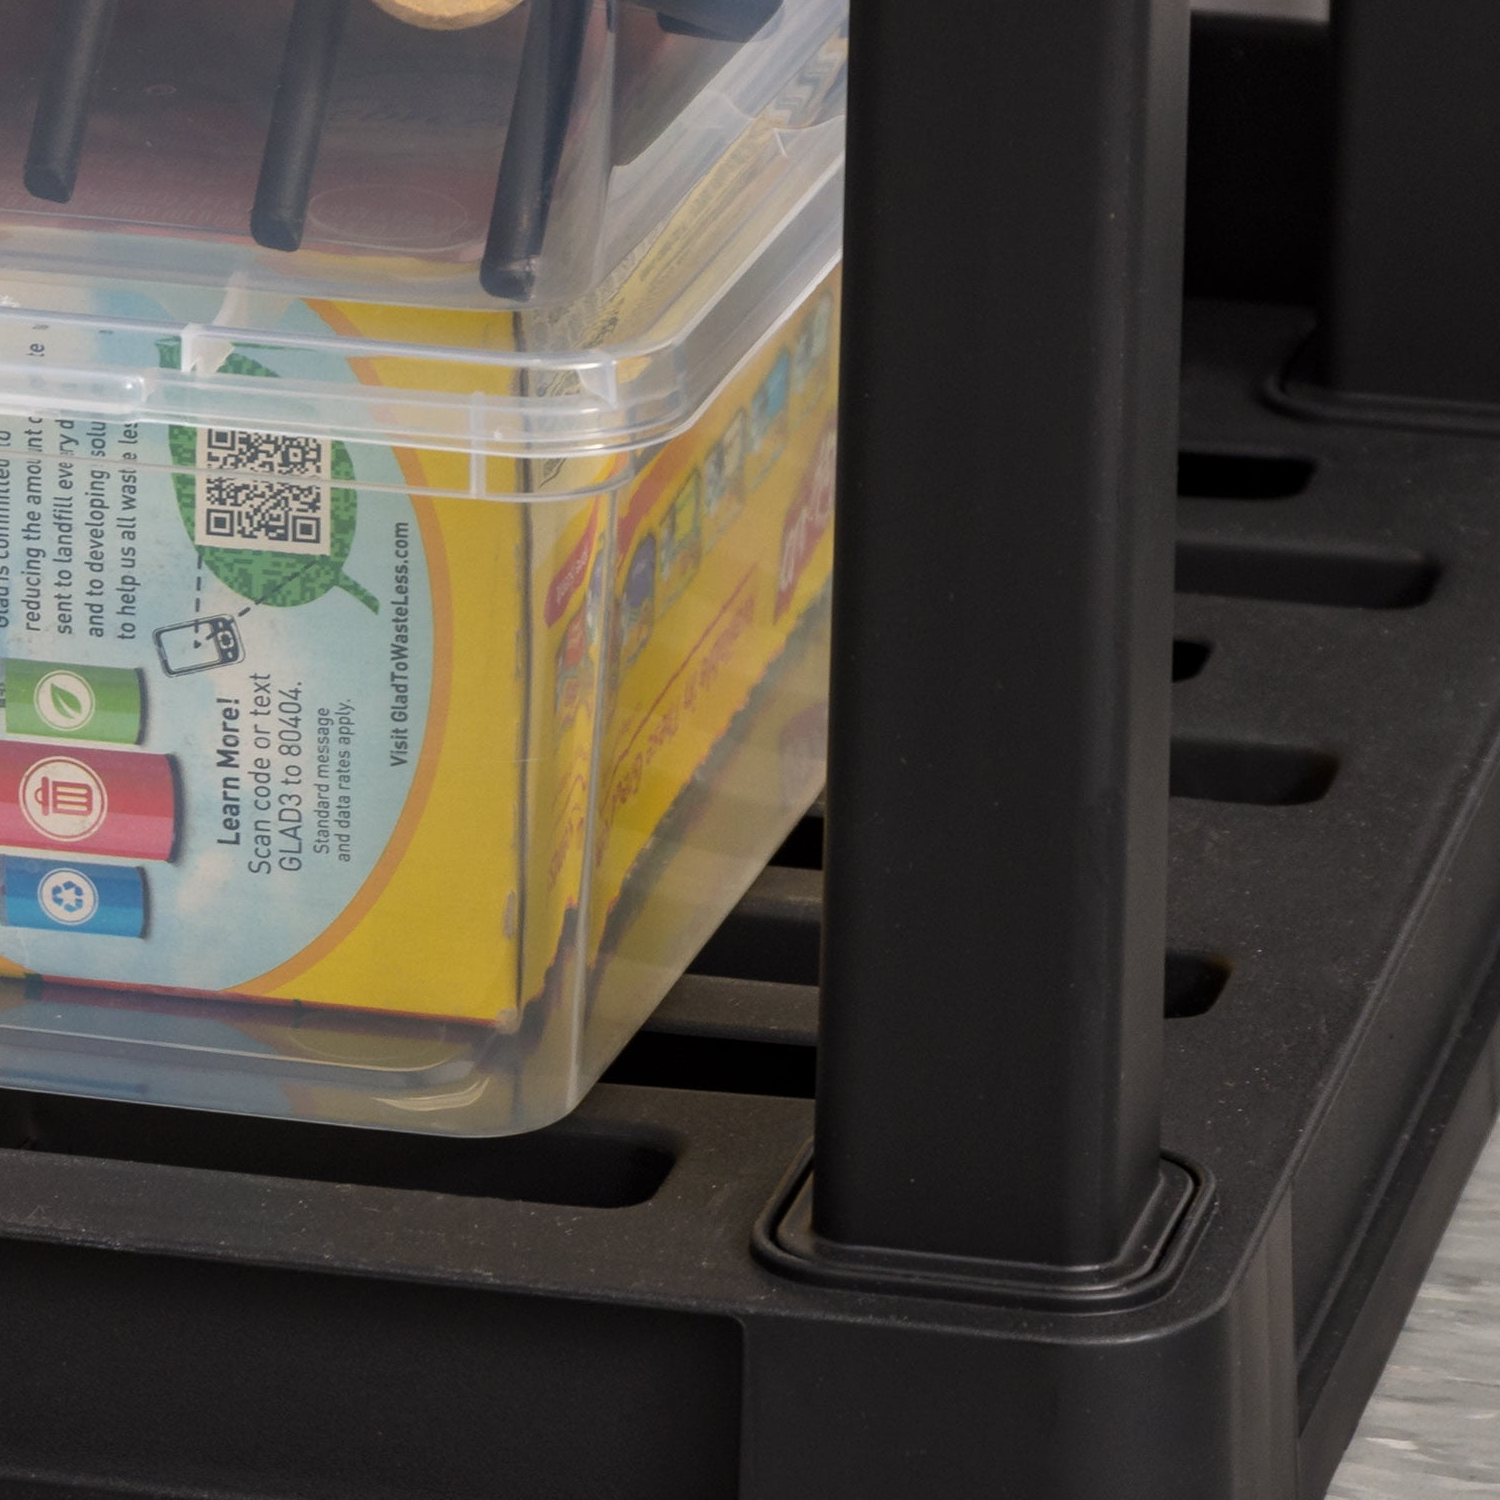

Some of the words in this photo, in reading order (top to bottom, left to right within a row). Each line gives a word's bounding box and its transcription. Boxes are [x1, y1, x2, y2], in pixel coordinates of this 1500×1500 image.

[24, 427, 43, 506] amount
[59, 432, 79, 490] every
[121, 451, 138, 512] waste
[21, 510, 42, 541] the
[53, 497, 73, 563] landfill
[85, 470, 111, 572] developing
[116, 516, 136, 541] all
[54, 569, 73, 588] to
[121, 546, 136, 568] us
[21, 546, 46, 632] reducing
[86, 579, 105, 596] to
[116, 574, 141, 617] help
[53, 595, 73, 634] sent
[85, 602, 104, 638] and
[116, 622, 136, 639] to
[390, 522, 409, 723] GladToWasteLess.com
[250, 673, 272, 721] text
[279, 681, 303, 756] 80404.
[217, 697, 241, 767] More!
[254, 724, 271, 749] or
[317, 707, 334, 778] message
[335, 699, 355, 745] apply.
[337, 750, 352, 790] rates
[390, 727, 408, 767] Visit
[248, 757, 272, 809] code
[283, 765, 302, 788] to
[217, 776, 241, 846] Learn
[279, 793, 302, 873] GLAD3
[313, 780, 330, 854] Standard
[334, 794, 351, 828] data
[248, 816, 272, 875] Scan
[334, 832, 351, 862] and
